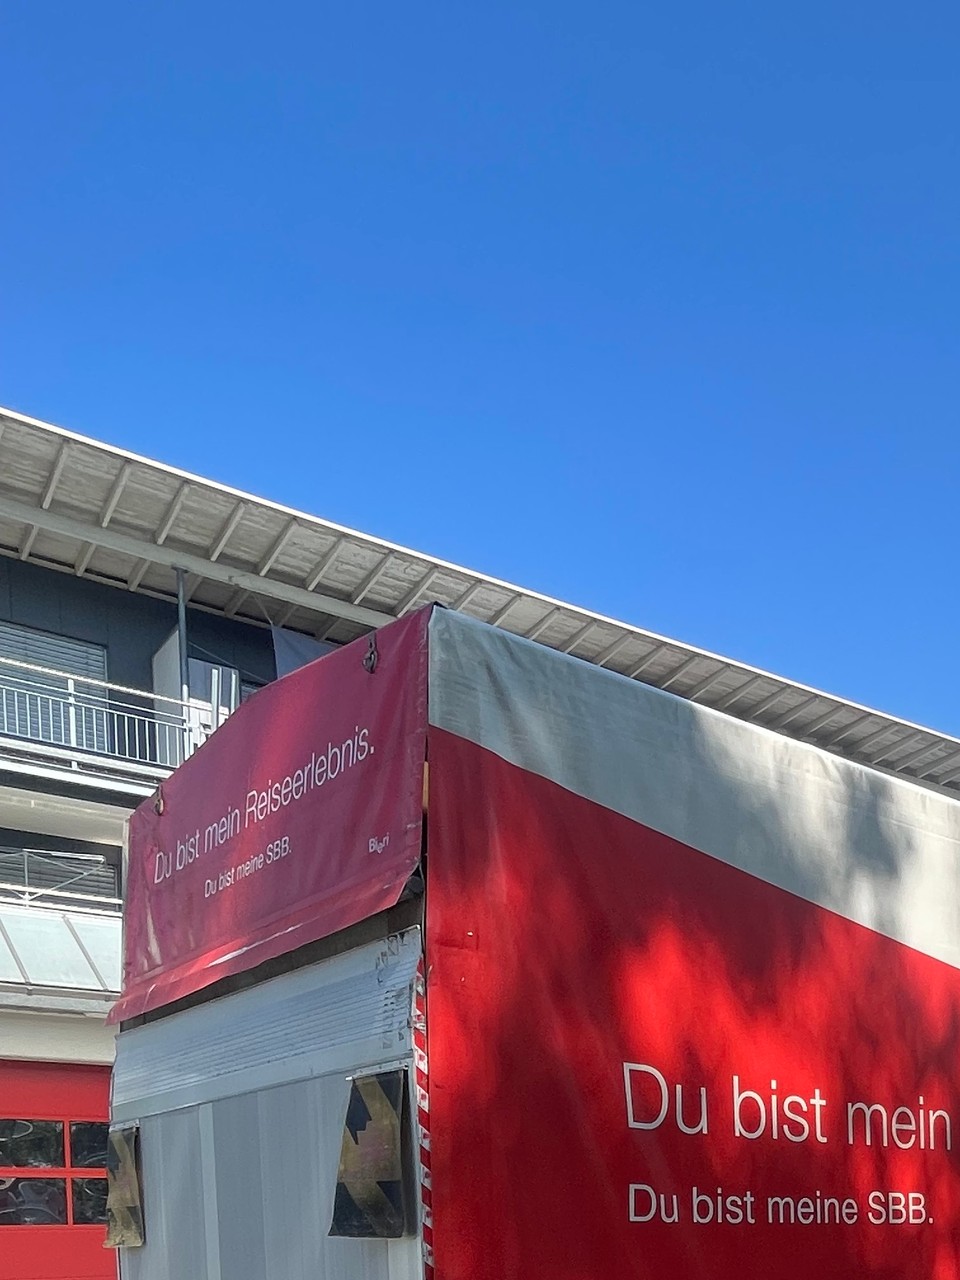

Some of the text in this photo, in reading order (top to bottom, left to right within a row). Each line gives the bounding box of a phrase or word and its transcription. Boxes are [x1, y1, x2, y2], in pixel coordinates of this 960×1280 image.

[153, 725, 375, 884] Du bist mein Reiseerlebnis.
[204, 836, 292, 898] Du bist meine SBB.
[622, 1061, 709, 1136] Du
[732, 1075, 829, 1144] bist
[847, 1095, 952, 1152] mein
[627, 1183, 935, 1225] Du bist meine SBB.
